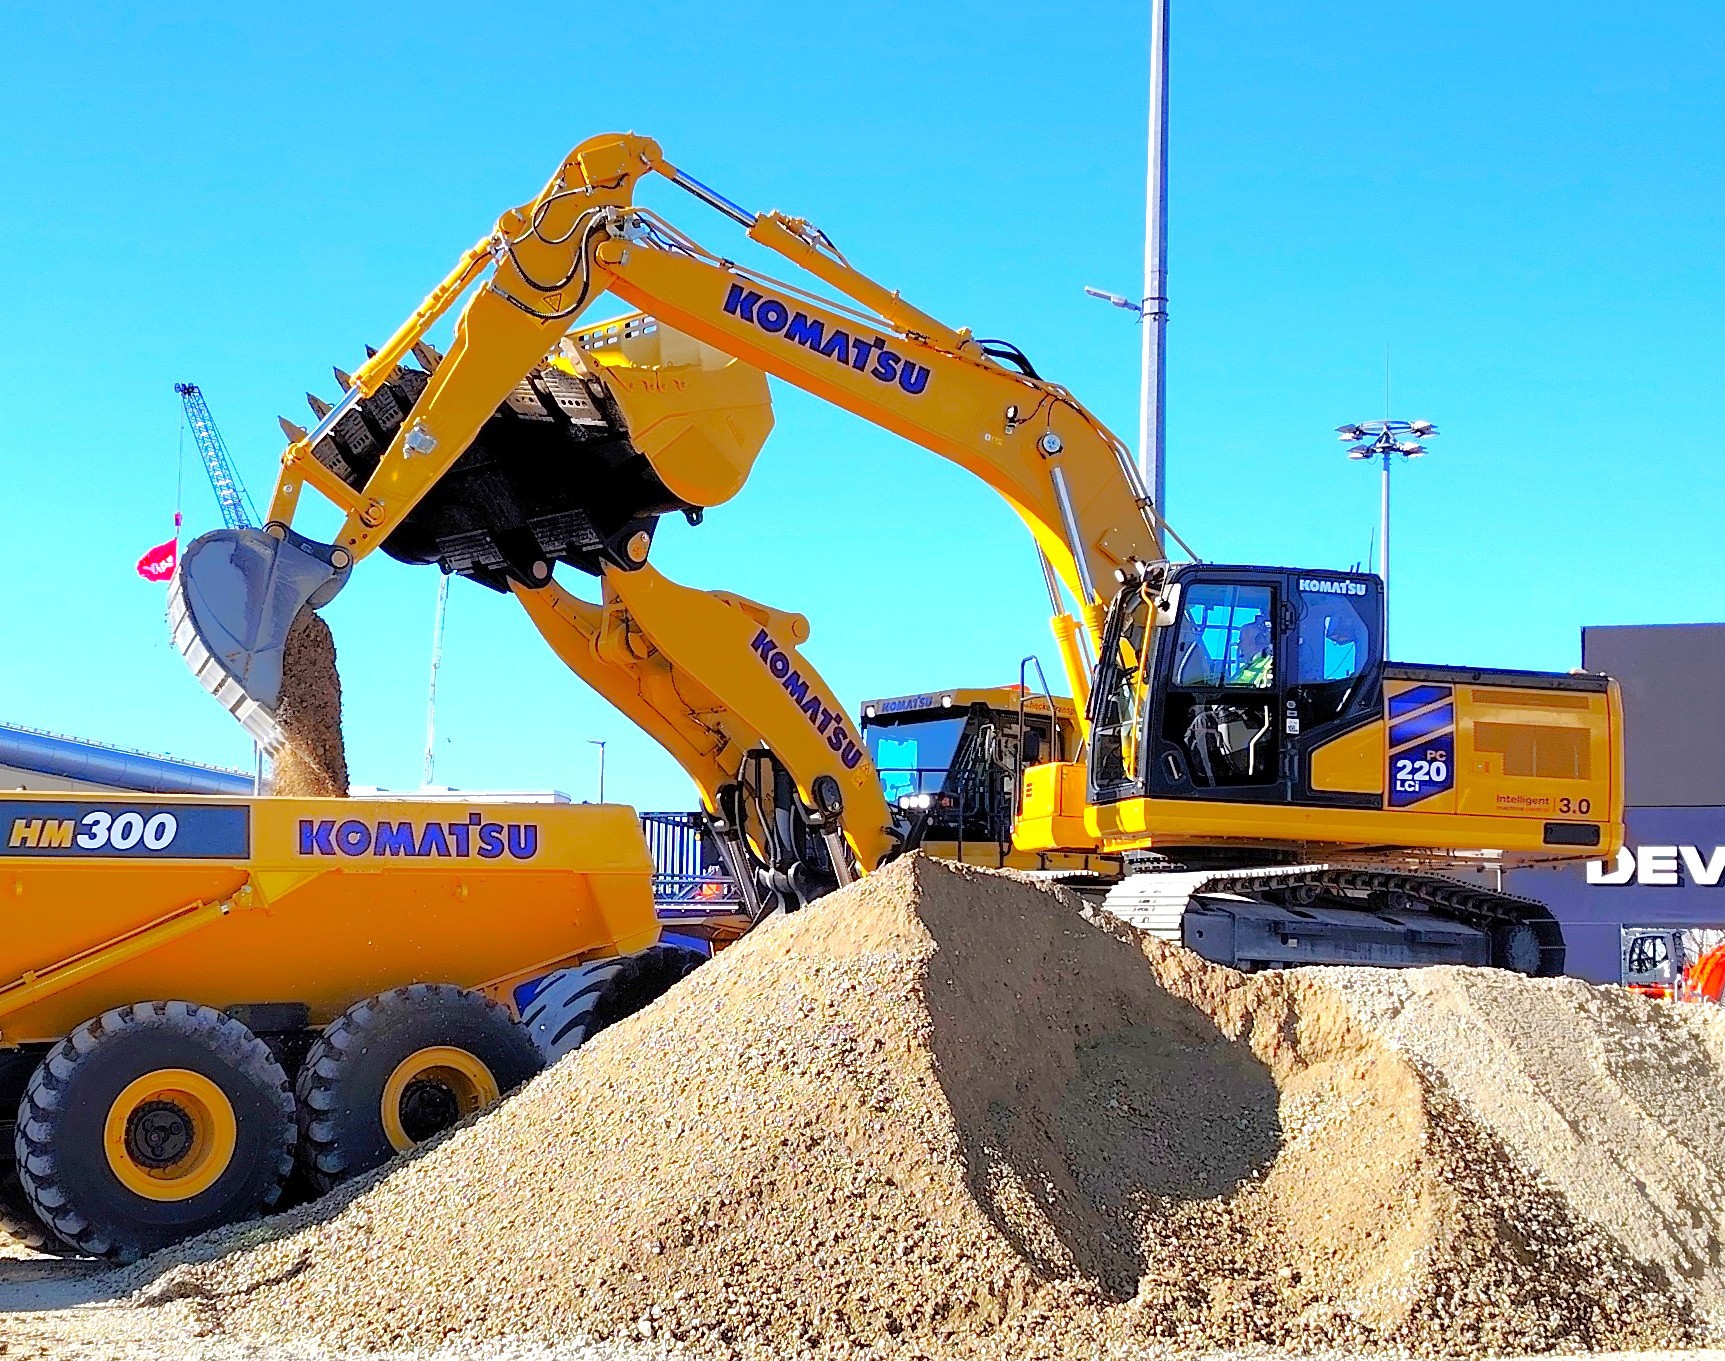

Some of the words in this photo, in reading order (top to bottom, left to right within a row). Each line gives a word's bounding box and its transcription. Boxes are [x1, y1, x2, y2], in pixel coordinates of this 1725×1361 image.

[723, 283, 931, 394] KOMATSU
[1299, 579, 1366, 595] KOMATSU
[751, 628, 863, 769] KOMATSU
[881, 695, 934, 712] KOMATSU
[1426, 750, 1447, 761] PC
[1396, 759, 1447, 782] 220
[1396, 780, 1420, 792] LCi
[1558, 797, 1591, 815] 3.0
[298, 812, 538, 860] KOMATSU
[1587, 845, 1725, 885] DEV
